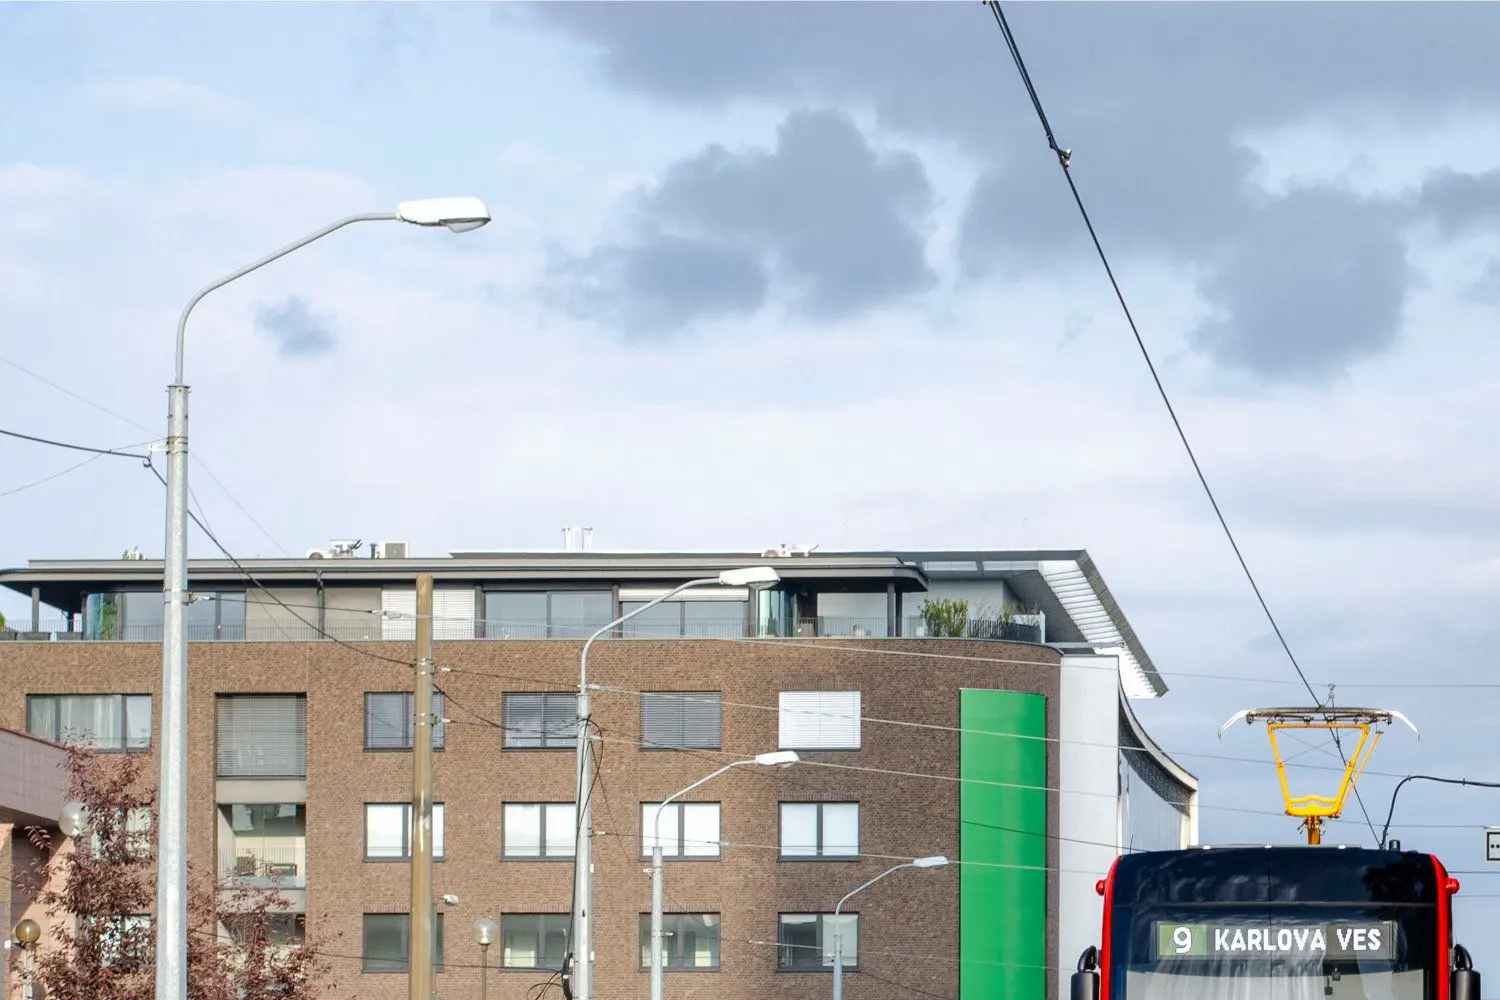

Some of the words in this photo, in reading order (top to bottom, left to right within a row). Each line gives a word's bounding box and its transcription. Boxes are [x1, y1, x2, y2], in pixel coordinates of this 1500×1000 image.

[1173, 926, 1192, 954] 9
[1214, 928, 1326, 951] KARLOVA
[1336, 928, 1382, 951] VES
